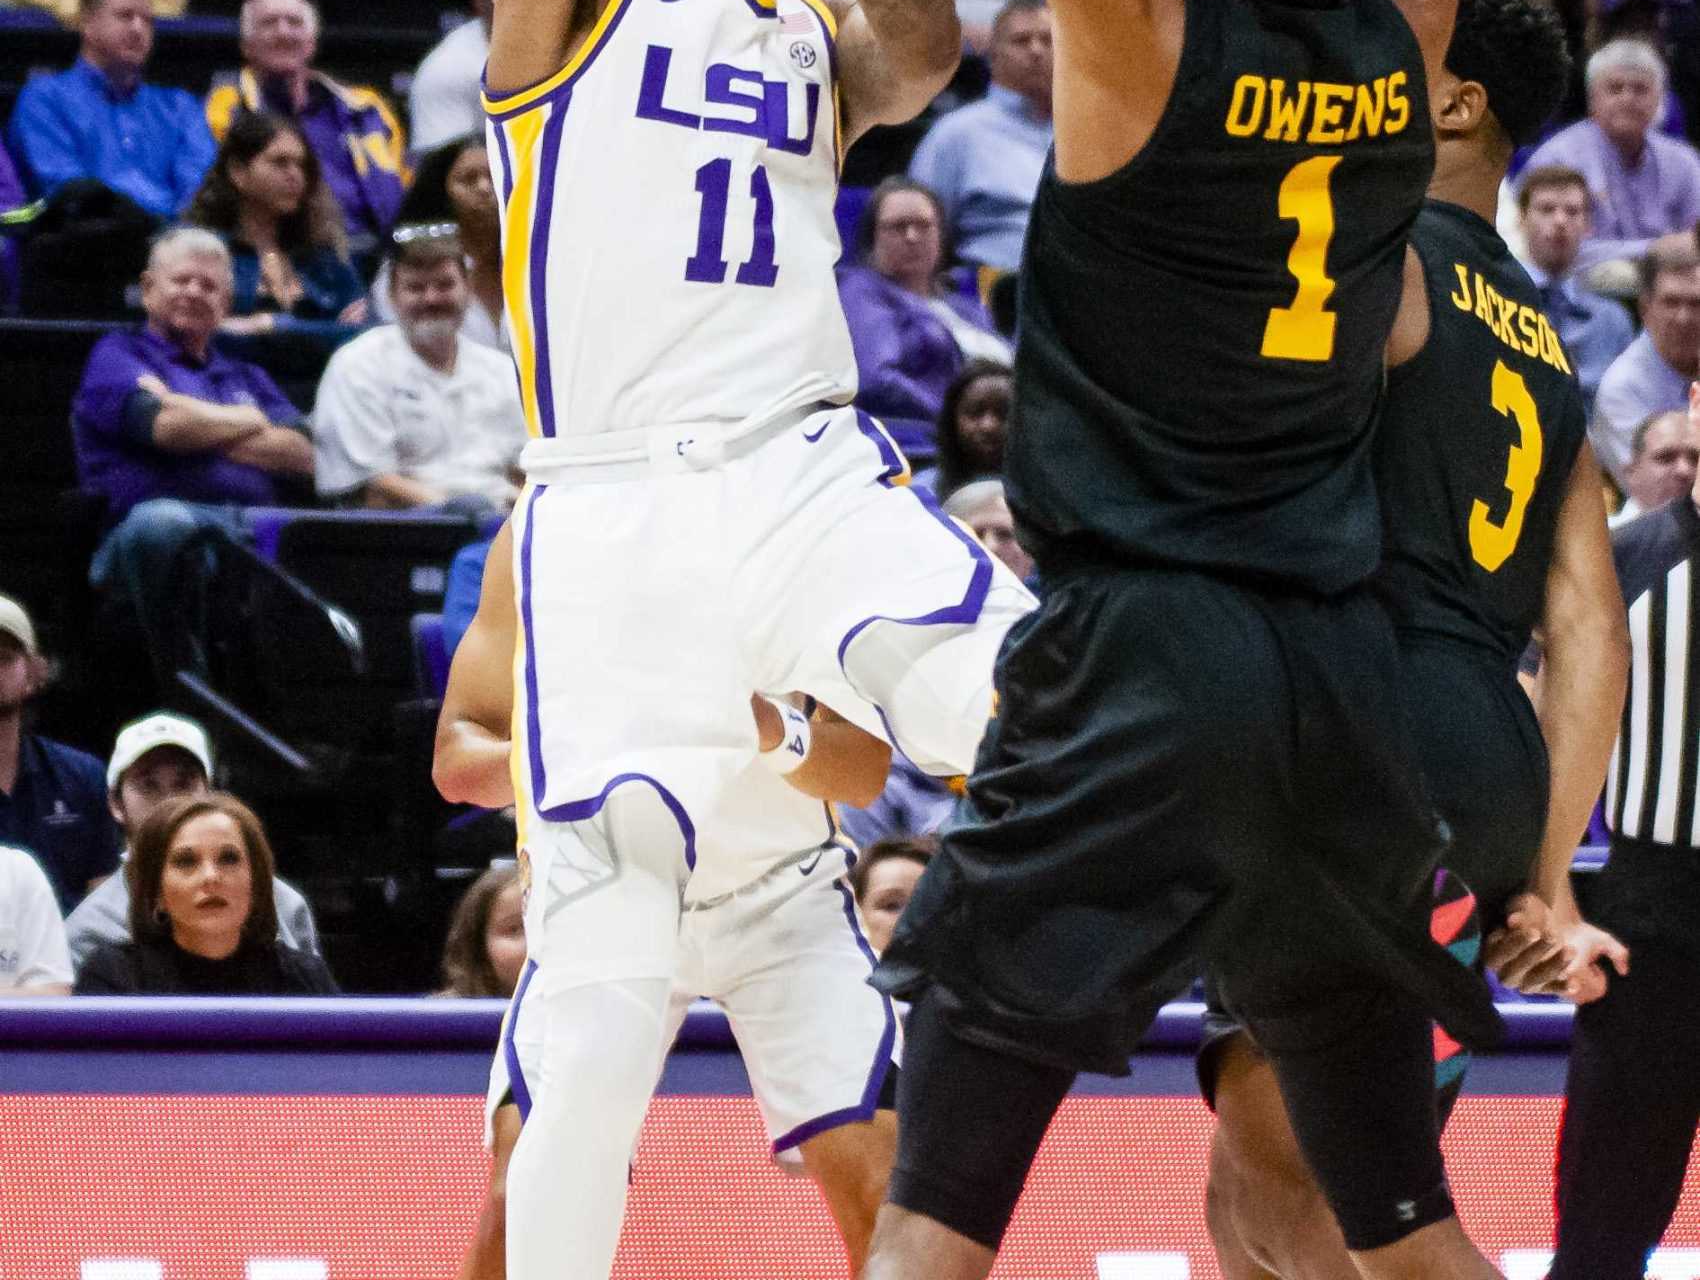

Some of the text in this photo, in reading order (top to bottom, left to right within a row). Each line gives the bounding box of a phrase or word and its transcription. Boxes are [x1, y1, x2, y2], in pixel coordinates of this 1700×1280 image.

[636, 44, 820, 156] LSU
[1225, 71, 1409, 143] OWENS
[684, 157, 779, 288] 11
[1260, 155, 1344, 361] 1
[1451, 262, 1572, 375] JACKSON
[1468, 359, 1543, 573] 3
